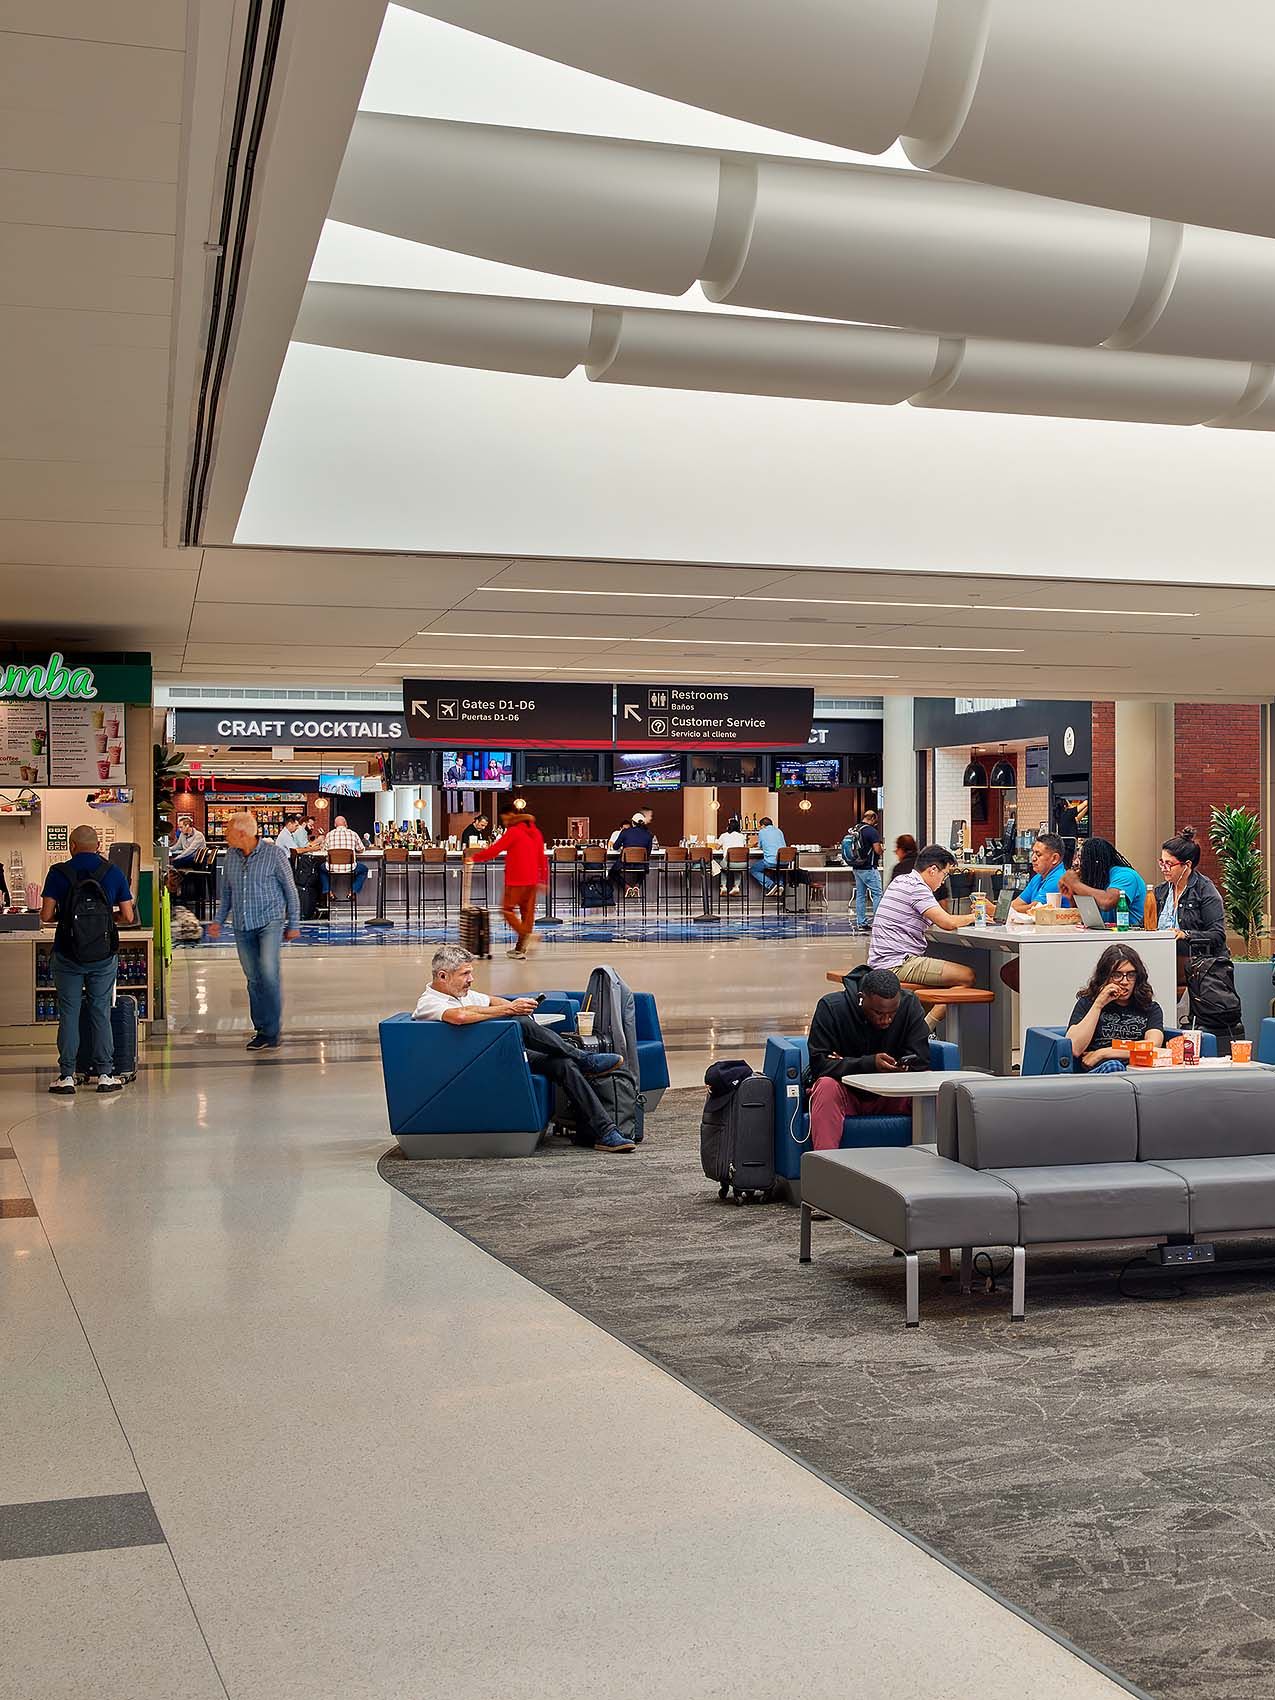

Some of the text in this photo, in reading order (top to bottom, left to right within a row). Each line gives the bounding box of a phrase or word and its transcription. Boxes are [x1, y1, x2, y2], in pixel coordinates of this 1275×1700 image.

[0, 652, 96, 698] mba
[671, 689, 729, 701] Restrooms
[462, 699, 535, 711] Gates D1-D6
[671, 703, 695, 711] Baños
[461, 713, 520, 721] Puertas D1-D6
[671, 716, 766, 728] Customer Service
[217, 719, 402, 738] CRAFT COCKTAILS
[671, 730, 737, 738] Servicio al cliente
